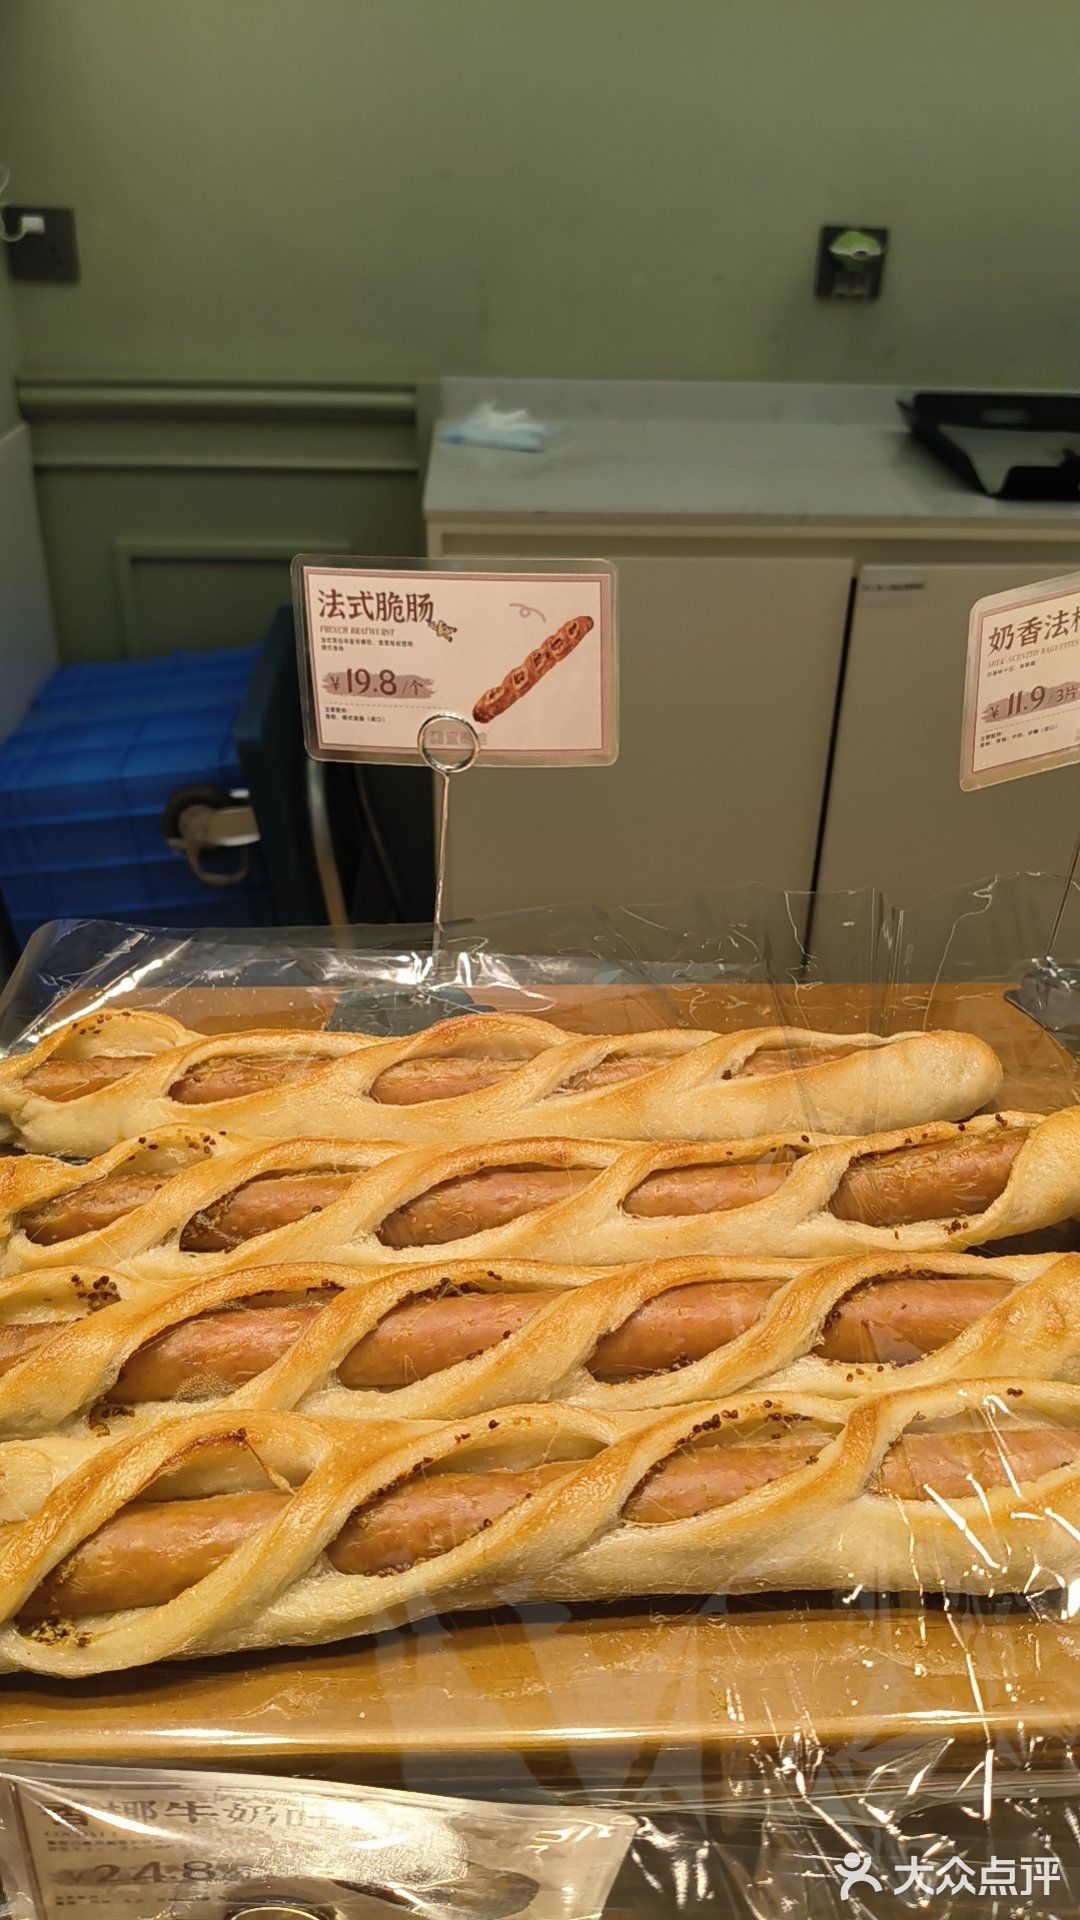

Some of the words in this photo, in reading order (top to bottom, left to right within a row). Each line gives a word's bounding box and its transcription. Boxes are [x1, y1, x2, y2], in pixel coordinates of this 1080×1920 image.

[318, 588, 433, 624] 法式脆肠
[320, 625, 348, 634] FRENCH
[350, 627, 395, 636] BRATWURST
